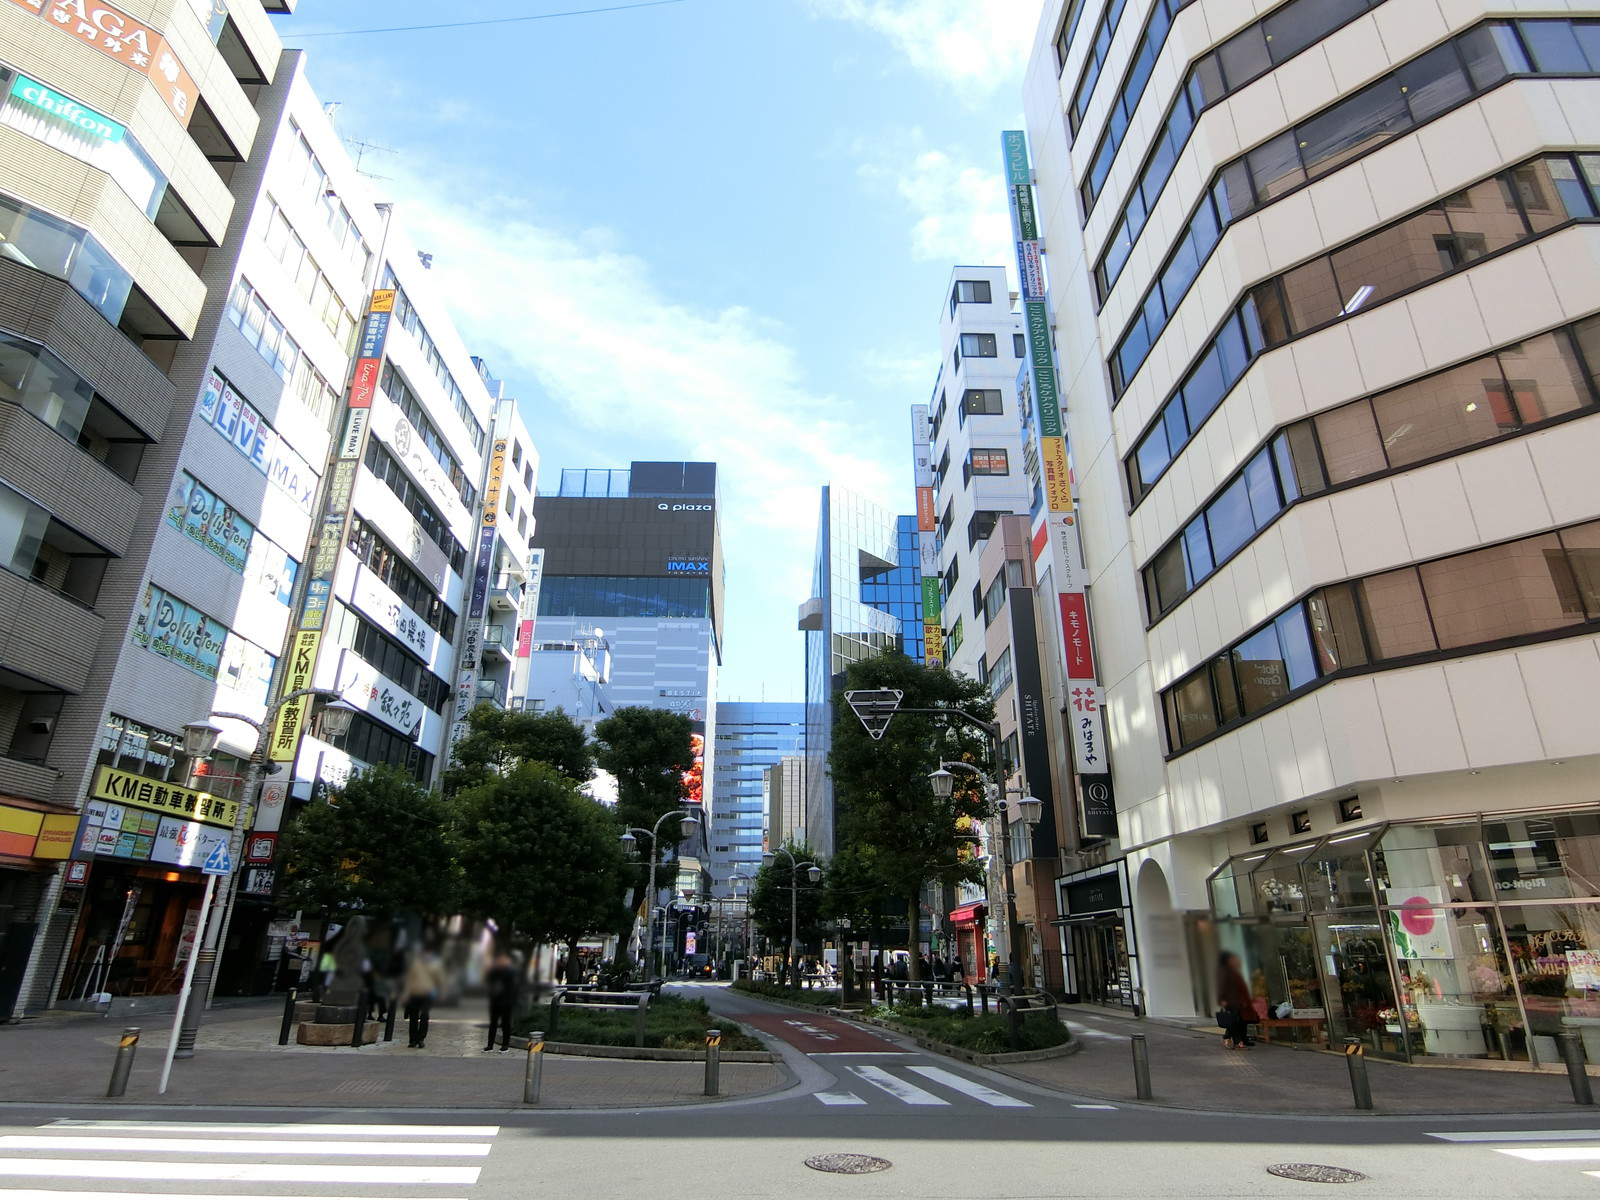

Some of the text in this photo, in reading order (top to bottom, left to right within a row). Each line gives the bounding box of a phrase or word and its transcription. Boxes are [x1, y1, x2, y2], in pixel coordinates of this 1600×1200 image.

[59, 0, 152, 56] AGA
[23, 86, 113, 138] chiffon
[273, 460, 313, 508] MAX
[657, 503, 712, 512] Q plaza
[191, 487, 225, 536] Dolly
[311, 581, 329, 594] 4F
[476, 543, 491, 600] かまくら
[668, 562, 709, 571] IMAX
[157, 598, 196, 646] Dolly
[307, 598, 324, 609] 3F
[925, 626, 934, 656] 歌広場
[934, 626, 942, 656] カラオケ
[1069, 611, 1083, 666] キモノモード
[1025, 694, 1035, 736] SHITATE
[1071, 687, 1097, 712] 花
[1080, 717, 1097, 766] みはるや
[105, 773, 226, 820] KM自動車教習所
